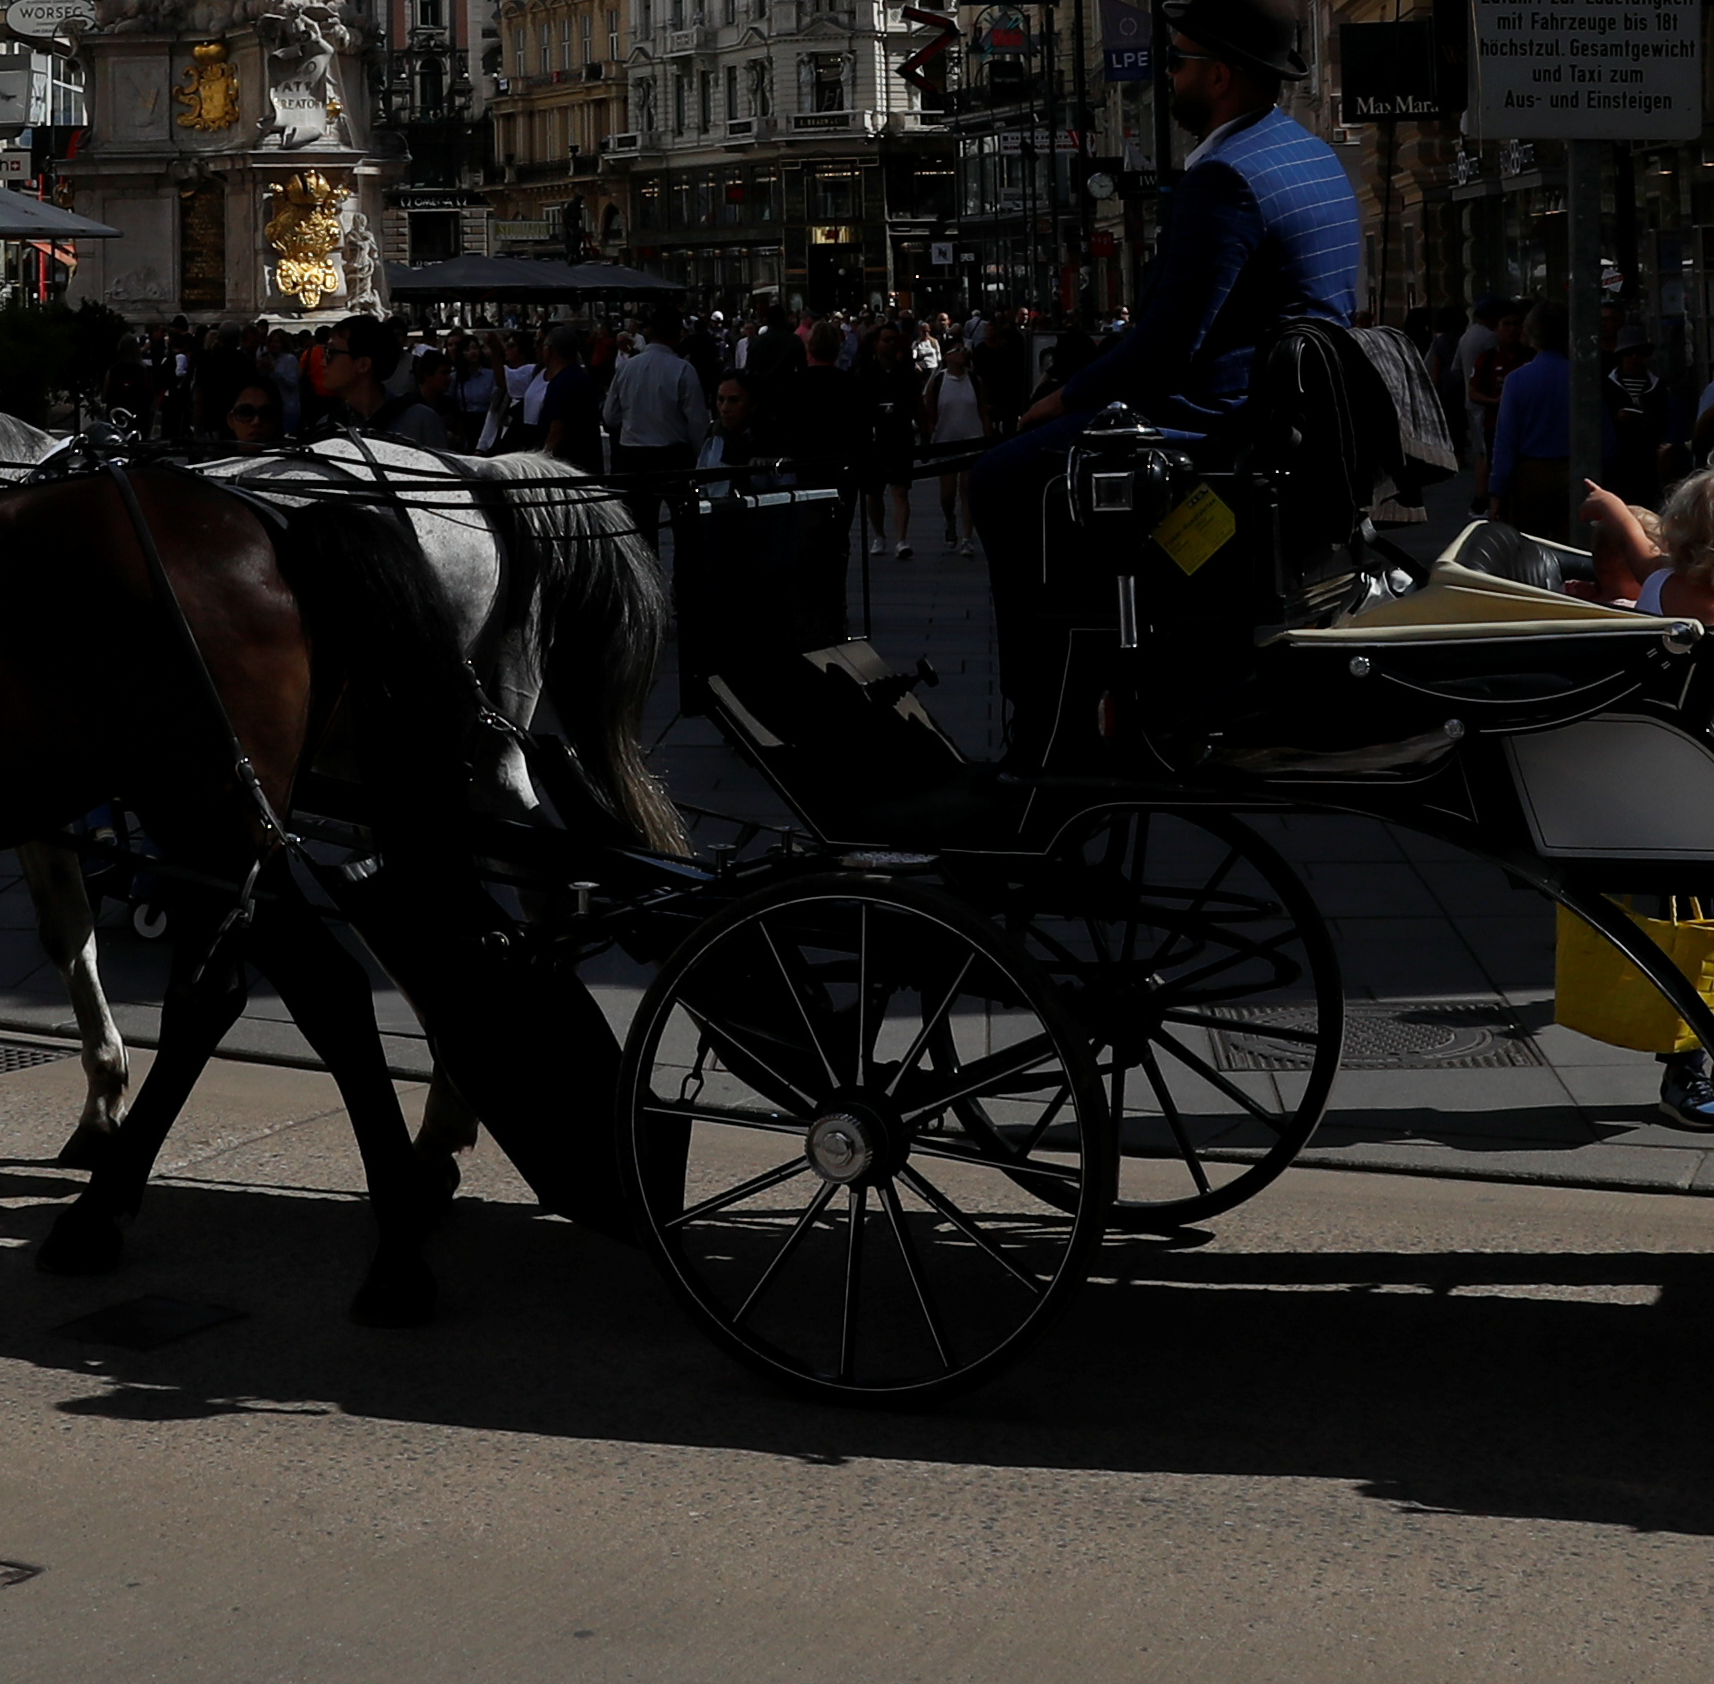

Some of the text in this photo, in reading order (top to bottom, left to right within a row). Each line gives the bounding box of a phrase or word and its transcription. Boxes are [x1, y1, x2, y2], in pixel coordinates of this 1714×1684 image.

[1497, 12, 1678, 35] mit Fahrzeuge bis 18t
[1112, 51, 1150, 69] LPE
[1480, 38, 1565, 57] höchstzul.
[1570, 38, 1695, 62] Gesamtgewicht
[1532, 64, 1643, 83] und Taxi zum
[1504, 90, 1672, 114] Aus- und Einsteigen
